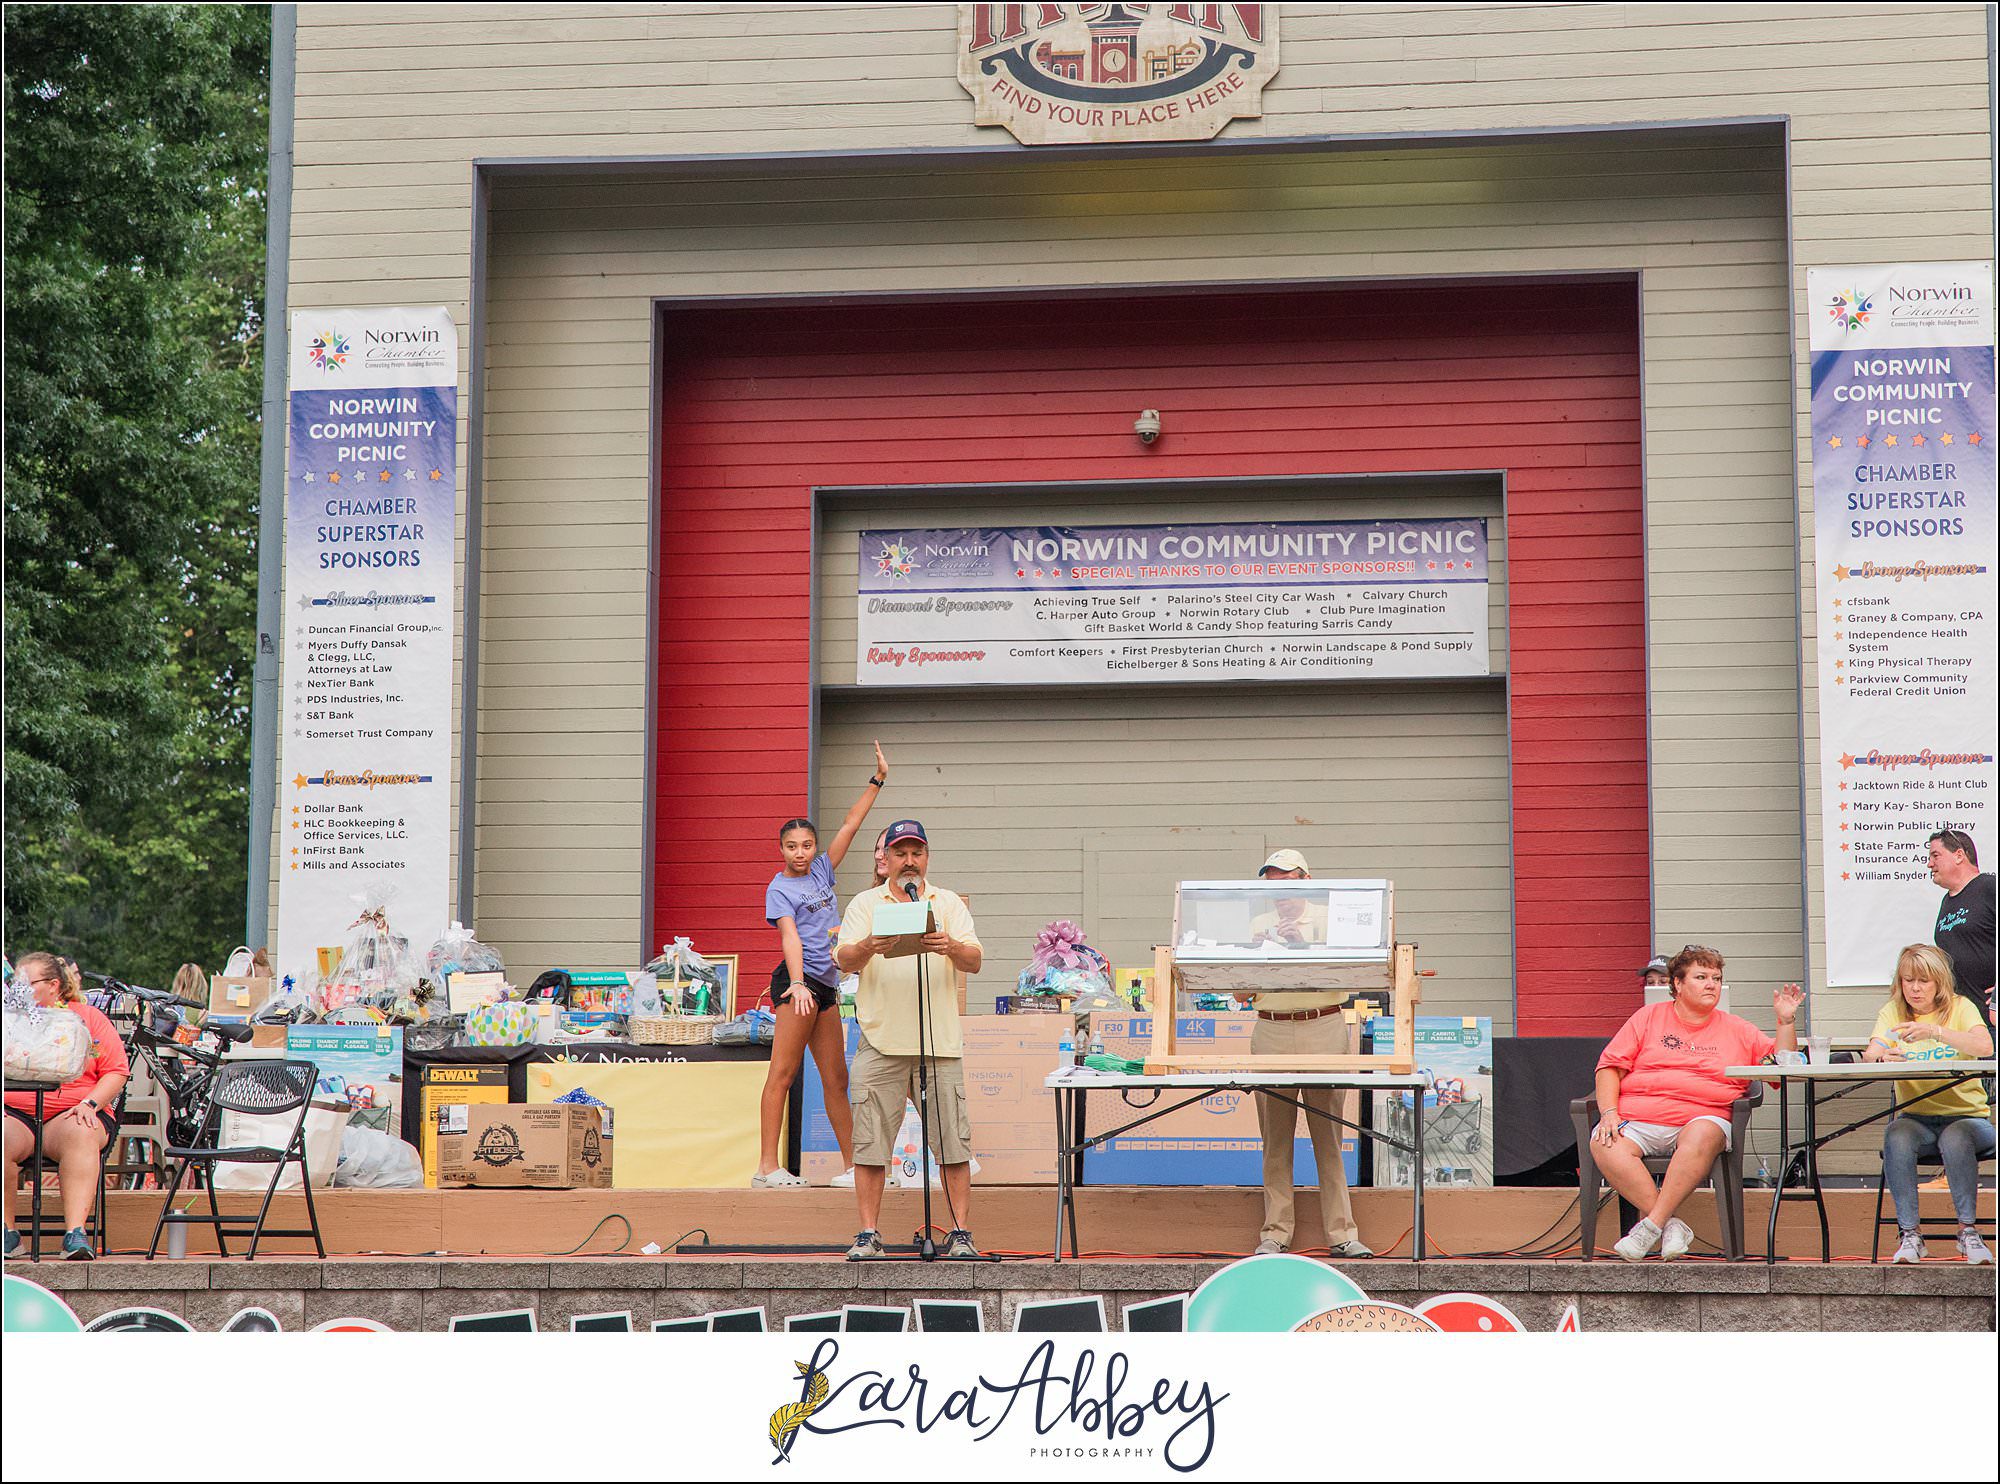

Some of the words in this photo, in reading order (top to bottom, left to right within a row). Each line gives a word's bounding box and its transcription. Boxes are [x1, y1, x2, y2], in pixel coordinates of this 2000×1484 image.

[991, 79, 1042, 115] FIND
[1048, 103, 1104, 126] YOUR
[1112, 102, 1180, 126] PLACE
[1186, 71, 1245, 113] HERE
[1889, 282, 1973, 302] Norwin
[365, 326, 440, 344] Norwin
[1853, 358, 1951, 377] NORWIN
[1834, 382, 1972, 402] COMMUNITY
[329, 398, 417, 415] NORWIN
[1866, 407, 1942, 426] PICNIC
[309, 421, 436, 439] COMMUNITY
[338, 445, 406, 462] PICNIC
[1854, 463, 1957, 483] CHAMBER
[325, 498, 417, 517] CHAMBER
[1847, 491, 1966, 511] SUPERSTAR
[317, 524, 424, 543] SUPERSTAR
[1851, 518, 1963, 538] SPONSORS
[925, 541, 989, 557] Norwin
[1013, 537, 1148, 562] NORWIN
[1159, 531, 1357, 559] COMMUNITY
[1368, 530, 1476, 556] PICNIC
[319, 550, 420, 569] SPONSORS
[1071, 567, 1134, 580] SPECIAL
[1139, 565, 1201, 578] THANKS
[1205, 564, 1227, 577] TO
[1231, 563, 1264, 577] OUR
[1268, 562, 1318, 576] EVENT
[1322, 560, 1416, 575] SPONSORS!!
[1861, 560, 1913, 582] Bronze
[1913, 559, 1979, 581] Sponsors
[326, 590, 366, 607] Silver
[366, 590, 425, 611] Sponsors
[1034, 597, 1088, 607] Achieving
[1092, 596, 1117, 605] True
[1123, 596, 1141, 605] Self
[1168, 594, 1222, 604] Palarino's
[1225, 593, 1253, 602] Steel
[1256, 593, 1278, 605] City
[1282, 593, 1302, 602] Car
[1305, 592, 1335, 601] Wash
[1362, 590, 1405, 602] Calvary
[1408, 590, 1448, 599] Church
[1847, 596, 1891, 607] cfsbank
[867, 597, 933, 614] Diamond
[935, 596, 1014, 617] Sponosors
[1179, 607, 1219, 617] Norwin
[1223, 607, 1260, 618] Rotary
[1263, 606, 1290, 615] Club
[1320, 605, 1346, 615] Club
[1349, 605, 1375, 614] Pure
[1378, 604, 1446, 615] Imagination
[1050, 611, 1089, 621] Harper
[1091, 610, 1119, 619] Auto
[1122, 609, 1156, 621] Group
[1847, 613, 1887, 625] Graney
[1901, 612, 1957, 623] Company,
[1960, 612, 1984, 621] CPA
[308, 625, 346, 634] Duncan
[349, 624, 394, 634] Financial
[1084, 624, 1105, 633] Gift
[1108, 623, 1144, 632] Basket
[1149, 622, 1182, 631] World
[1197, 621, 1232, 634] Candy
[1235, 620, 1264, 632] Shop
[1267, 619, 1318, 632] featuring
[1322, 619, 1354, 629] Sarris
[1357, 618, 1393, 630] Candy
[1848, 629, 1928, 641] Independence
[1931, 628, 1968, 639] Health
[308, 642, 338, 651] Myers
[340, 640, 369, 650] Duffy
[371, 639, 407, 648] Dansak
[1122, 646, 1147, 656] First
[1151, 645, 1221, 657] Presbyterian
[1224, 643, 1263, 655] Church
[1282, 643, 1323, 652] Norwin
[1326, 641, 1387, 653] Landscape
[1401, 641, 1430, 651] Pond
[1434, 640, 1473, 652] Supply
[1848, 644, 1888, 654] System
[317, 653, 350, 663] Clegg,
[353, 653, 376, 662] LLC,
[867, 648, 906, 667] Ruby
[908, 647, 986, 667] Sponosors
[1009, 647, 1055, 657] Comfort
[1058, 647, 1104, 658] Keepers
[307, 665, 357, 674] Attorneys
[360, 665, 370, 673] at
[373, 664, 392, 673] Law
[1107, 659, 1178, 672] Eichelberger
[1192, 658, 1219, 668] Sons
[1222, 657, 1266, 671] Heating
[1280, 656, 1297, 667] Air
[1300, 655, 1374, 669] Conditioning
[1849, 658, 1875, 669] King
[1878, 657, 1923, 669] Physical
[1926, 656, 1972, 668] Therapy
[307, 679, 346, 688] NexTier
[349, 679, 375, 688] Bank
[1849, 674, 1900, 684] Parkview
[1903, 673, 1968, 685] Community
[1850, 687, 1893, 697] Federal
[1896, 687, 1931, 696] Credit
[1933, 686, 1966, 695] Union
[307, 695, 327, 704] PDS
[330, 694, 383, 704] Industries,
[386, 694, 404, 703] Inc.
[306, 711, 326, 720] S&T
[329, 711, 354, 720] Bank
[306, 729, 354, 739] Somerset
[357, 729, 382, 737] Trust
[385, 728, 434, 738] Company
[1866, 750, 1918, 771] Copper
[1919, 749, 1985, 771] Sponsors
[322, 770, 360, 787] Brass
[361, 769, 421, 790] Sponsors
[1852, 781, 1900, 792] Jacktown
[1903, 780, 1926, 790] Ride
[1938, 780, 1962, 790] Hunt
[1965, 779, 1987, 788] Club
[304, 804, 335, 813] Dollar
[338, 804, 363, 813] Bank
[1853, 801, 1880, 812] Mary
[1884, 800, 1909, 811] Kay-
[1912, 800, 1952, 810] Sharon
[1955, 800, 1985, 809] Bone
[303, 819, 325, 828] HLC
[328, 819, 395, 829] Bookkeeping
[1854, 822, 1894, 831] Norwin
[1898, 820, 1933, 831] Public
[1936, 819, 1976, 831] Library
[303, 831, 335, 840] Office
[338, 831, 383, 840] Services,
[386, 830, 409, 839] LLC.
[303, 846, 336, 855] InFirst
[339, 846, 364, 854] Bank
[1854, 841, 1884, 851] State
[1887, 841, 1920, 850] Farm-
[302, 860, 326, 869] Mills
[329, 860, 348, 869] and
[351, 859, 406, 869] Associates
[1855, 854, 1908, 864] Insurance
[1855, 872, 1891, 881] William
[1893, 871, 1928, 882] Snyder
[1104, 1023, 1123, 1032] F30
[1186, 1020, 1206, 1033] 4K
